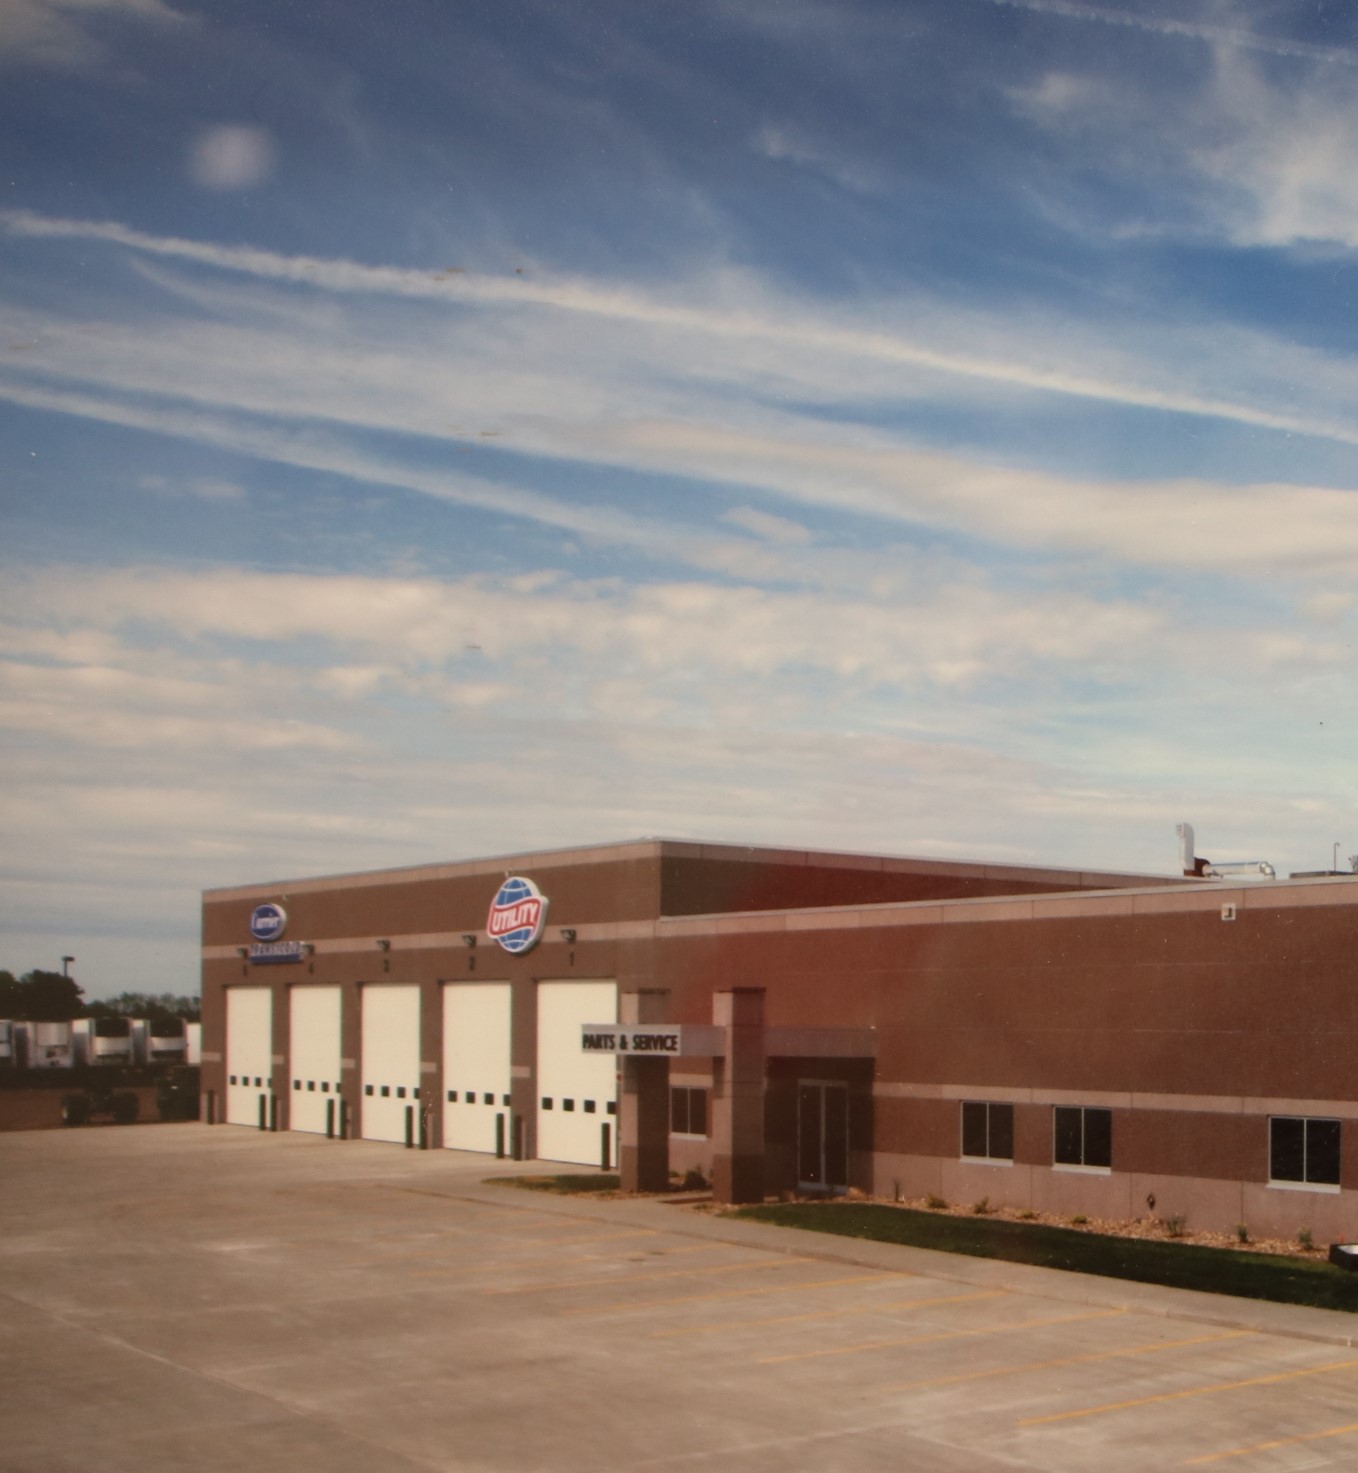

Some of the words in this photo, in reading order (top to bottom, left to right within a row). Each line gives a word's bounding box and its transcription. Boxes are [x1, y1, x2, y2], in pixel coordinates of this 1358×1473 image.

[491, 902, 539, 933] UTILITY
[582, 1034, 615, 1049] PARTS
[619, 1034, 628, 1050] &
[632, 1034, 678, 1051] SERVICE
